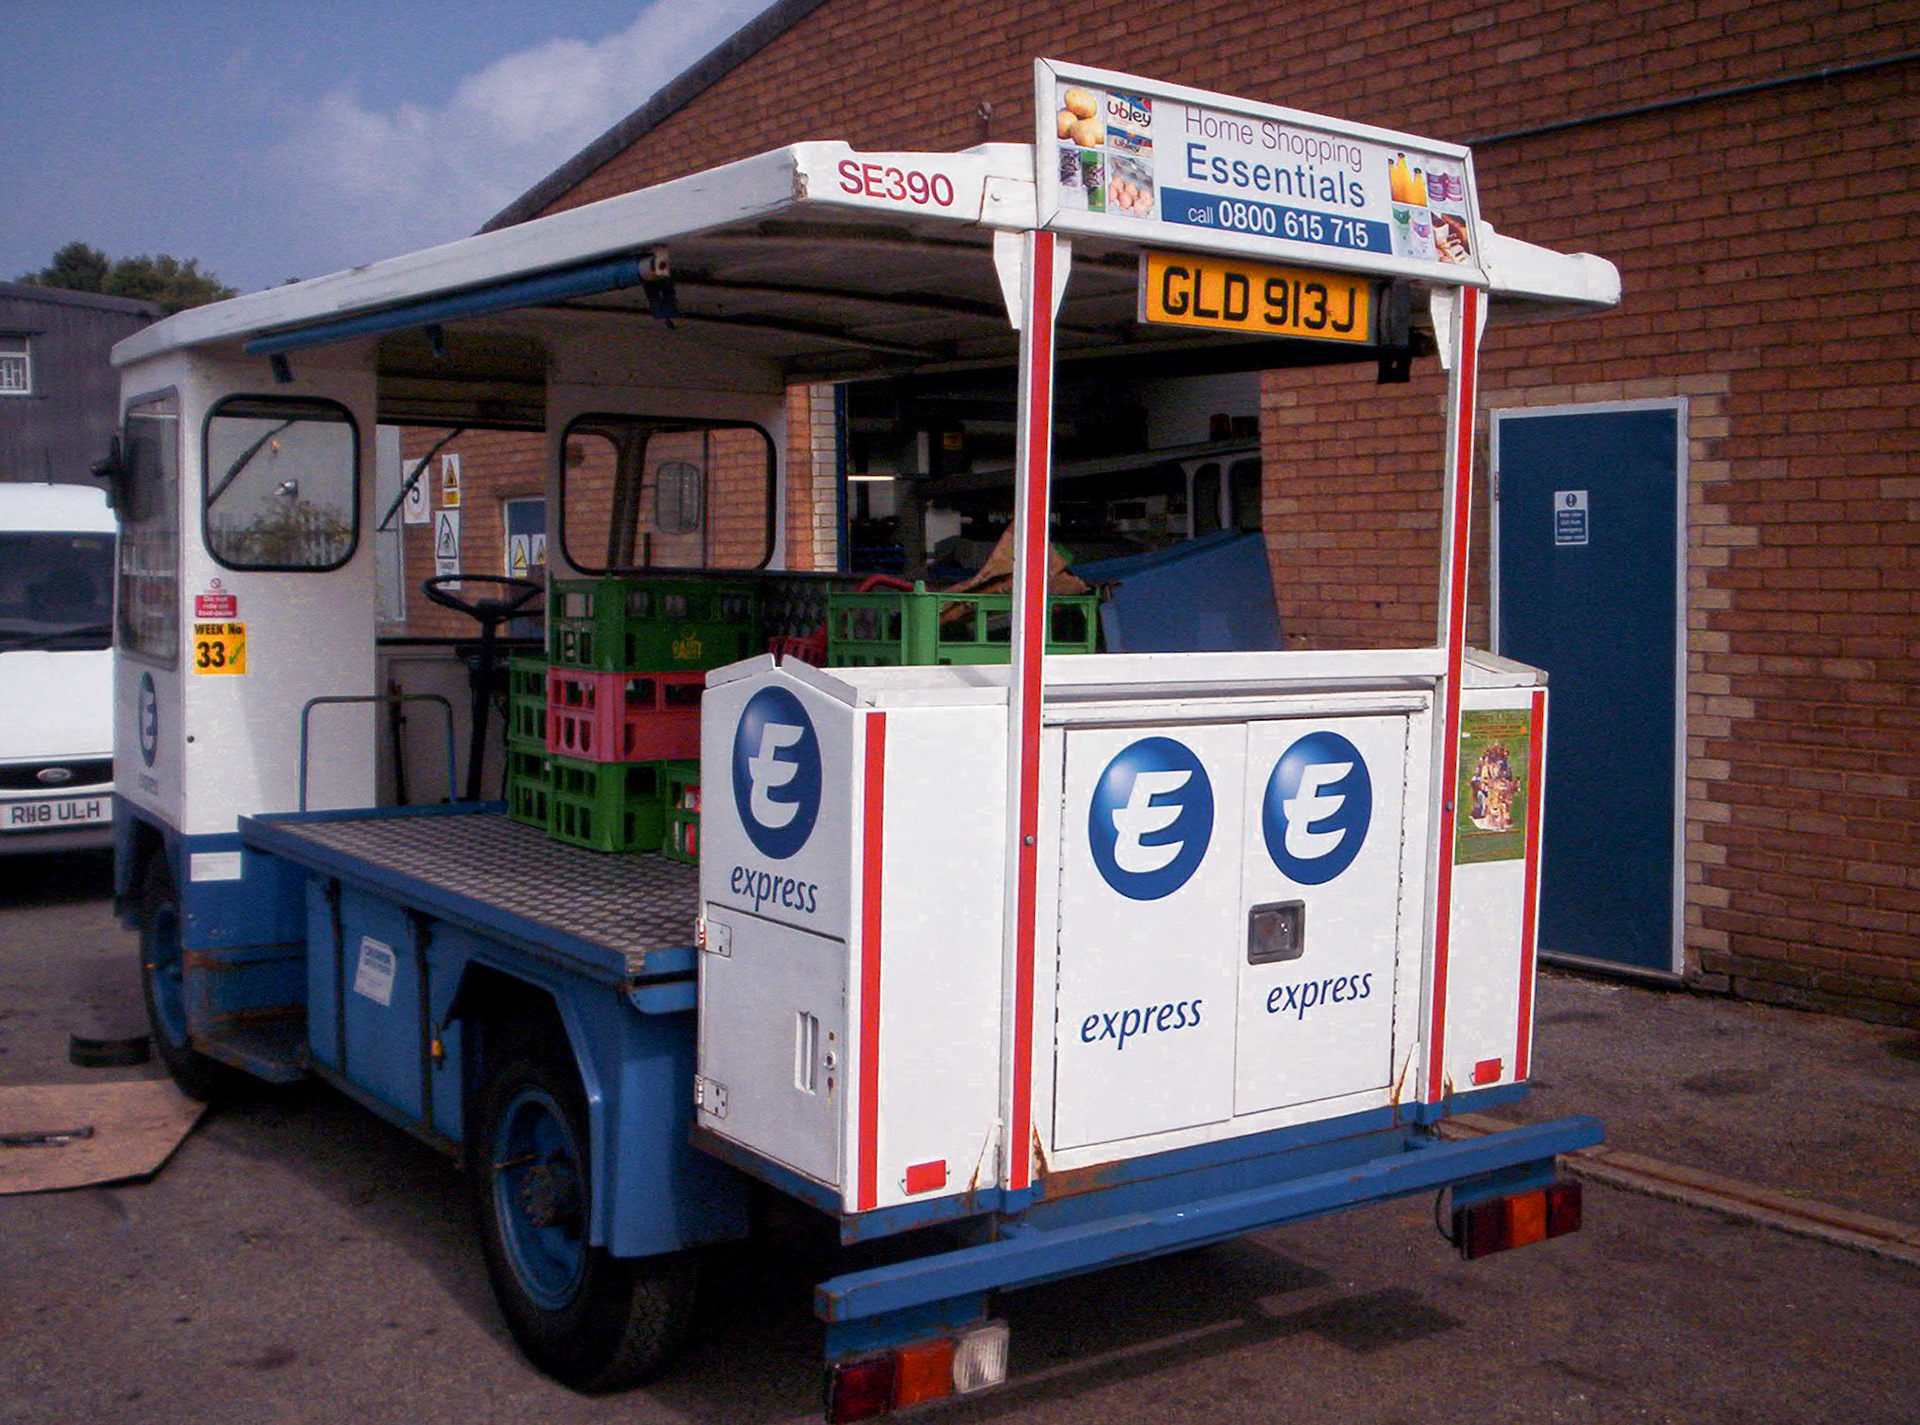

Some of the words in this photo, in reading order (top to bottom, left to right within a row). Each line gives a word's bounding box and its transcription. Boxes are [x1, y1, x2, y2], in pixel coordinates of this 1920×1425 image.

[1184, 105, 1253, 146] Home
[1261, 122, 1362, 173] Shopping
[838, 159, 955, 207] SE390
[1186, 142, 1366, 208] Essentials
[1187, 206, 1215, 225] call
[1218, 200, 1276, 234] 0800
[1284, 211, 1324, 241] 615
[1330, 218, 1370, 248] 715
[1162, 265, 1250, 322] GLD
[1263, 278, 1356, 333] 913J
[194, 623, 224, 635] WEEK
[196, 641, 226, 668] 33
[57, 800, 101, 821] ULH
[731, 866, 819, 914] express
[1265, 972, 1372, 1021] express
[1080, 999, 1203, 1051] express
